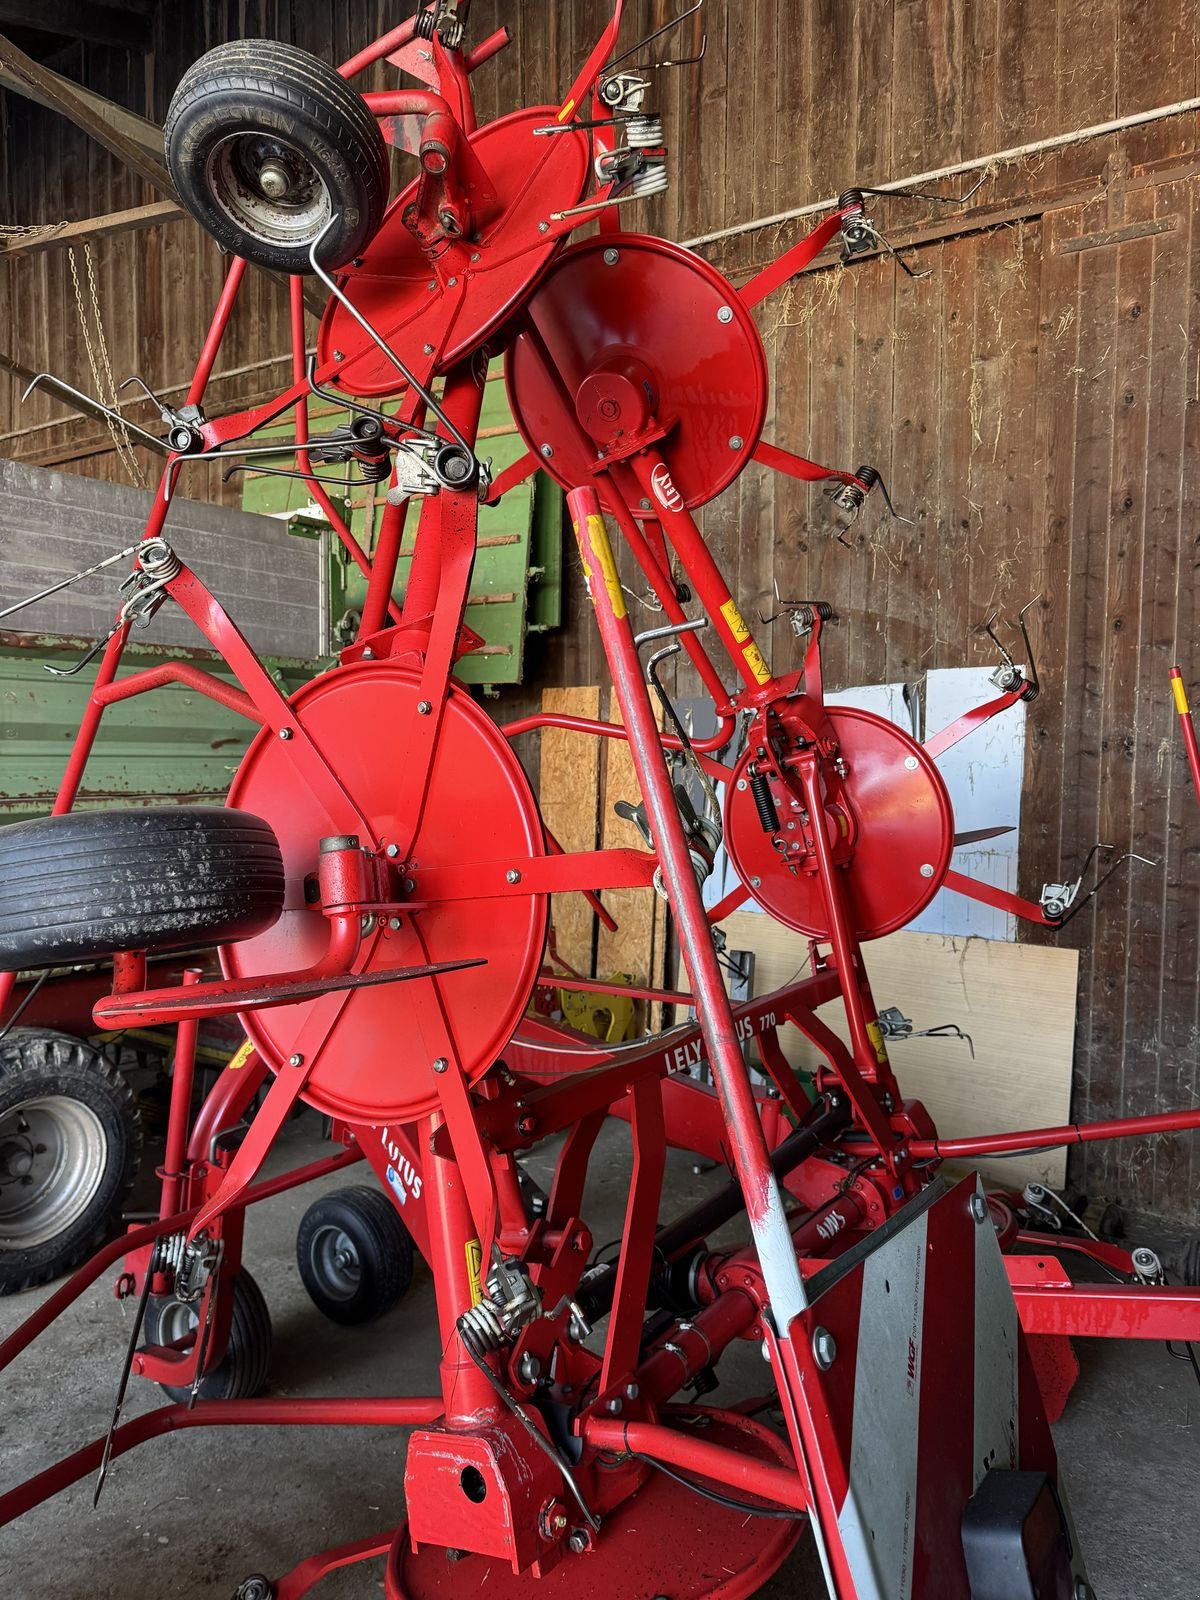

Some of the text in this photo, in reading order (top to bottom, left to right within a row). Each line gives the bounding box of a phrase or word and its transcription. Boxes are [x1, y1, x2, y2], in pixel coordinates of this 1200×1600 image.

[654, 472, 681, 506] LELY
[664, 1039, 702, 1075] LELY
[760, 1012, 776, 1031] 770
[381, 1126, 422, 1199] LOTUS
[908, 1336, 917, 1379] WGF
